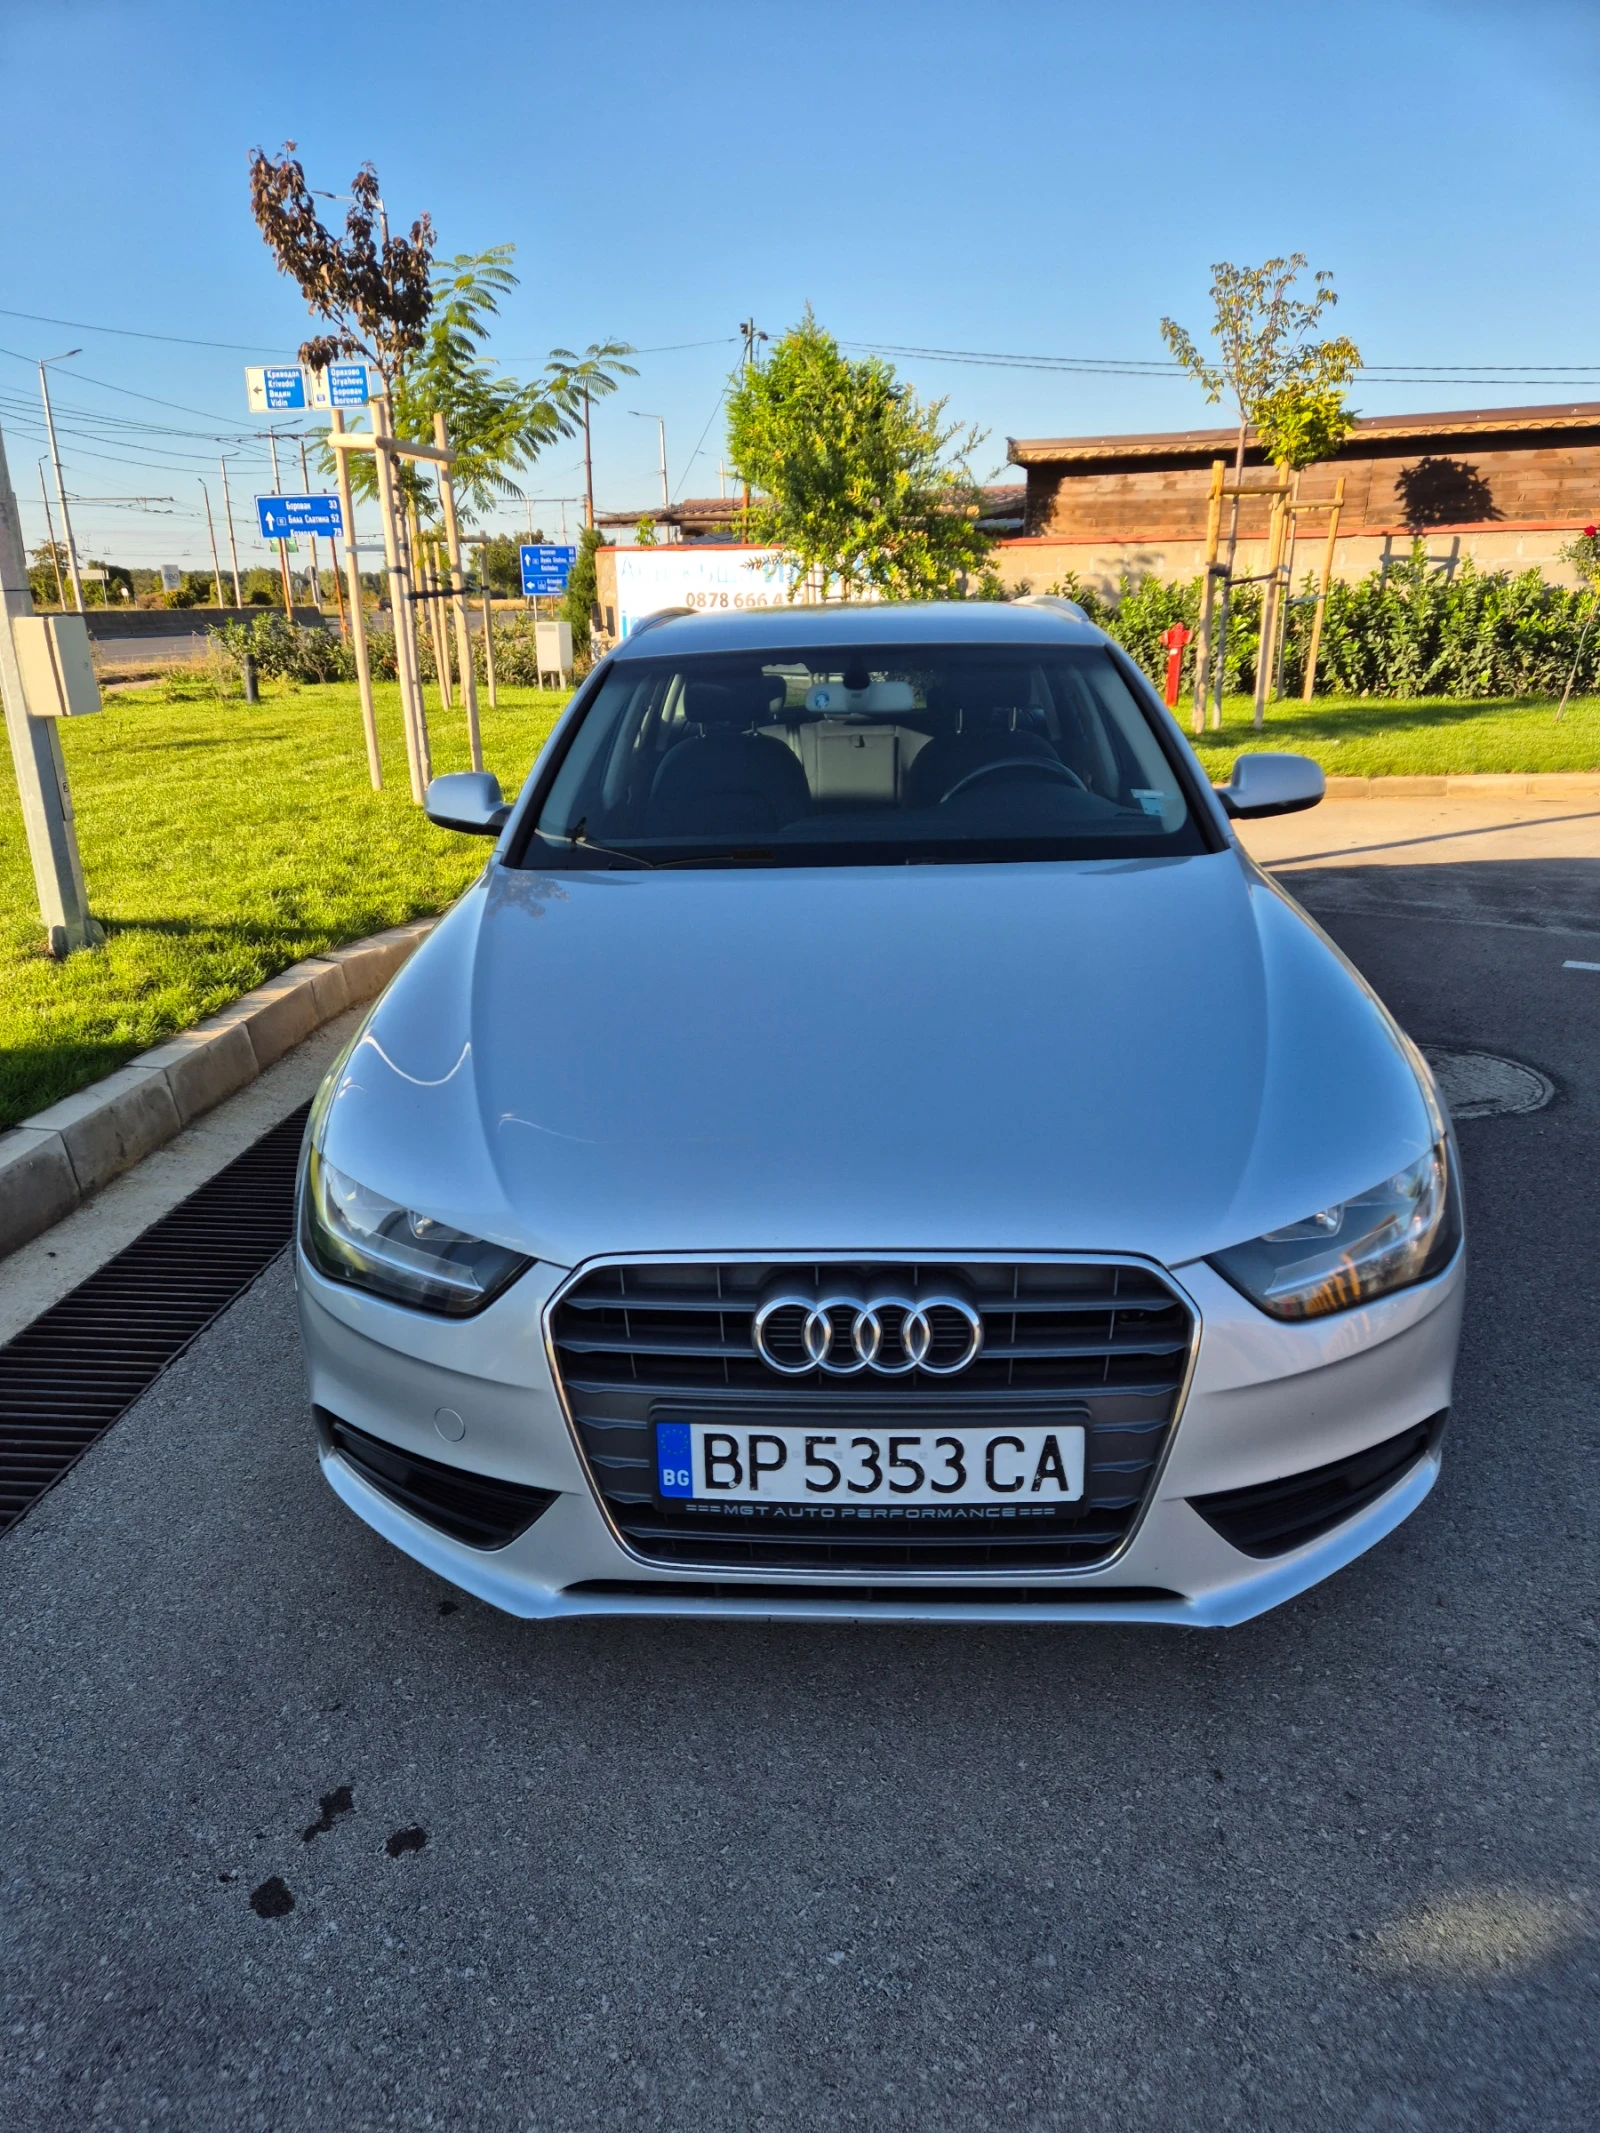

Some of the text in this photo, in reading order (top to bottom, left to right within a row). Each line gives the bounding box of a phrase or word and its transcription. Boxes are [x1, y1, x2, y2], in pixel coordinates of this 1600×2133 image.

[267, 370, 300, 379] Криводол
[331, 368, 360, 377] Оряхово
[268, 379, 295, 388] Krivodol
[332, 377, 363, 387] Oryahovo
[269, 390, 291, 398] Видин
[333, 387, 362, 396] Борован
[271, 399, 288, 407] Vidin
[334, 396, 362, 404] Borovan
[286, 500, 338, 512] Борован 33
[288, 514, 303, 524] Бяла
[304, 514, 329, 524] Слатина
[330, 513, 340, 523] 52
[685, 592, 729, 608] 0878
[733, 592, 768, 607] 666
[703, 1433, 1070, 1494] BP 5353 CA
[663, 1469, 689, 1487] BG
[774, 1506, 836, 1518] AUTO
[841, 1507, 1016, 1518] PERFORMANCE
